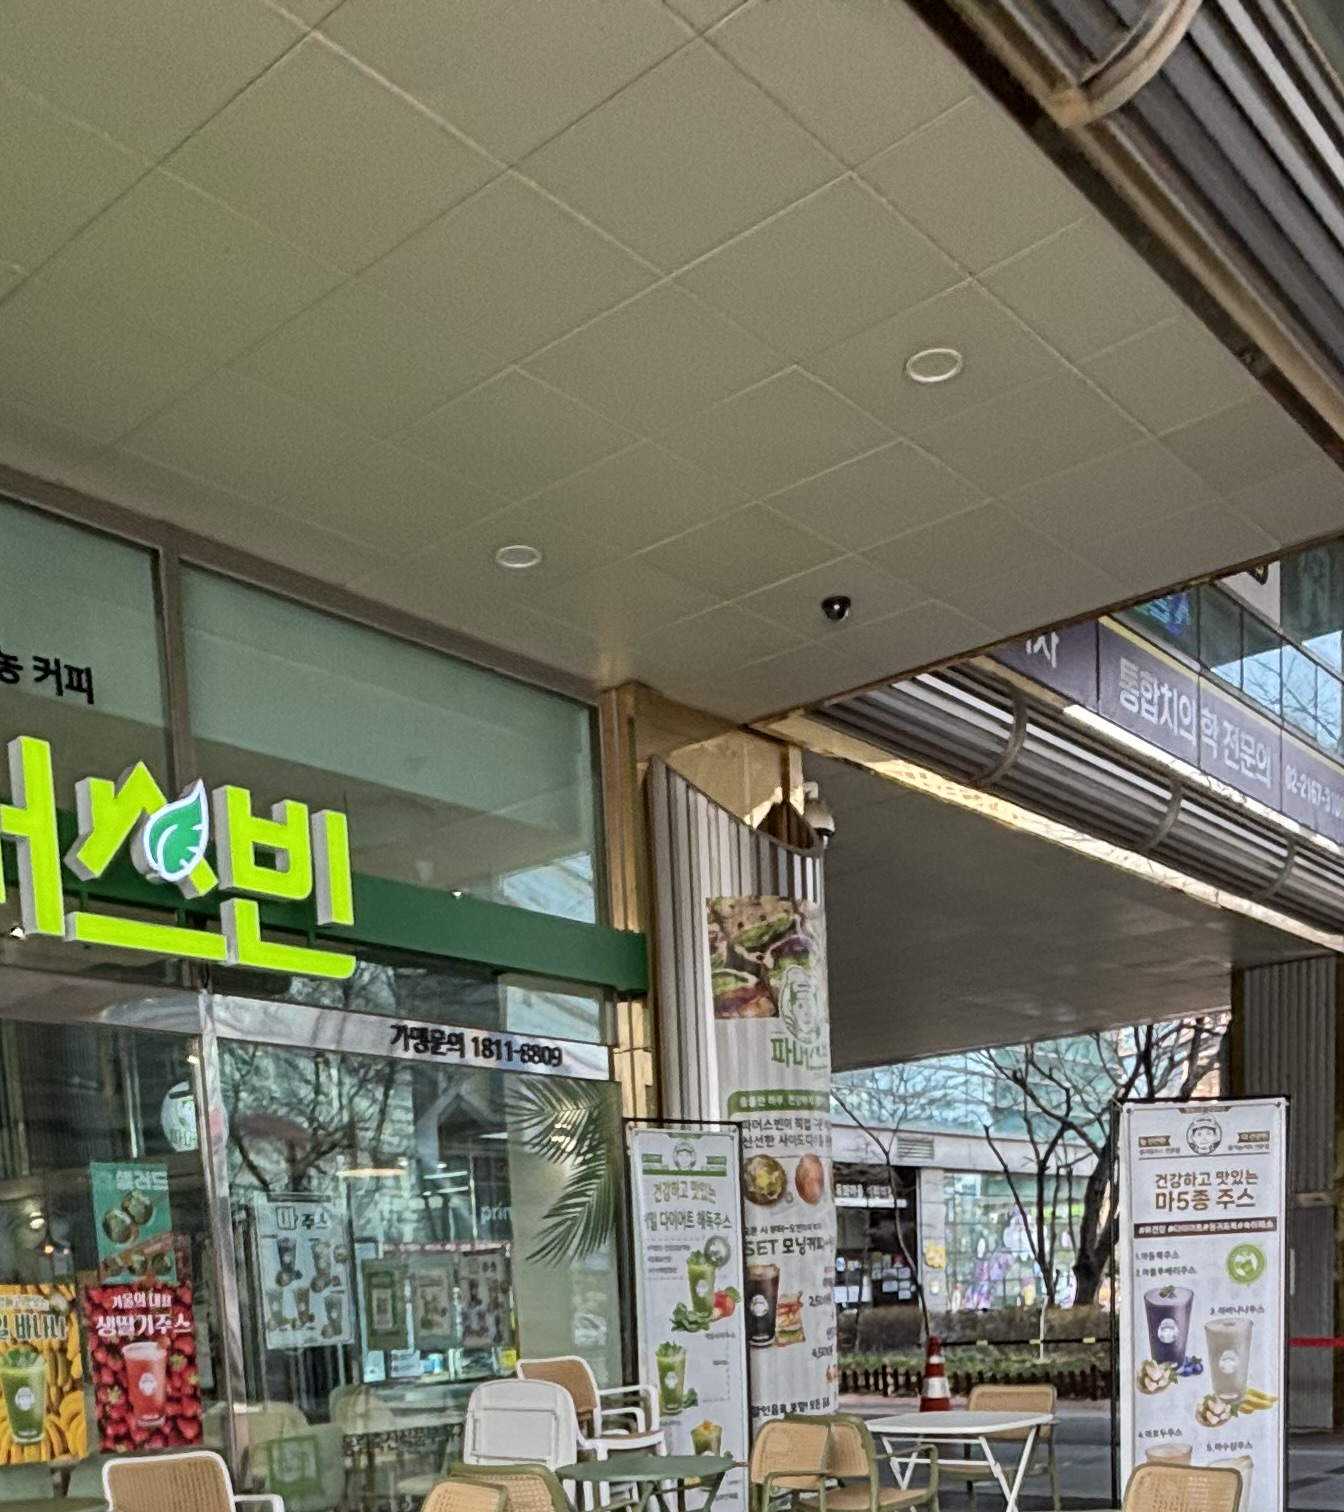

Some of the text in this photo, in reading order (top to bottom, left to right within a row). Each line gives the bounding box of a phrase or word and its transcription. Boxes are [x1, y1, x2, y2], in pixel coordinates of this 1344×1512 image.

[33, 655, 95, 705] 커피
[1119, 657, 1218, 760] 통합치의학
[1223, 720, 1272, 790] 전문의
[390, 1023, 466, 1059] 가맹문의
[1154, 1169, 1259, 1190] 건강하고 맛있는
[1155, 1187, 1256, 1212] 마5종 주스
[745, 1239, 779, 1257] SET
[12, 1313, 68, 1342] 바나나
[95, 1312, 194, 1338] 생딸기주스
